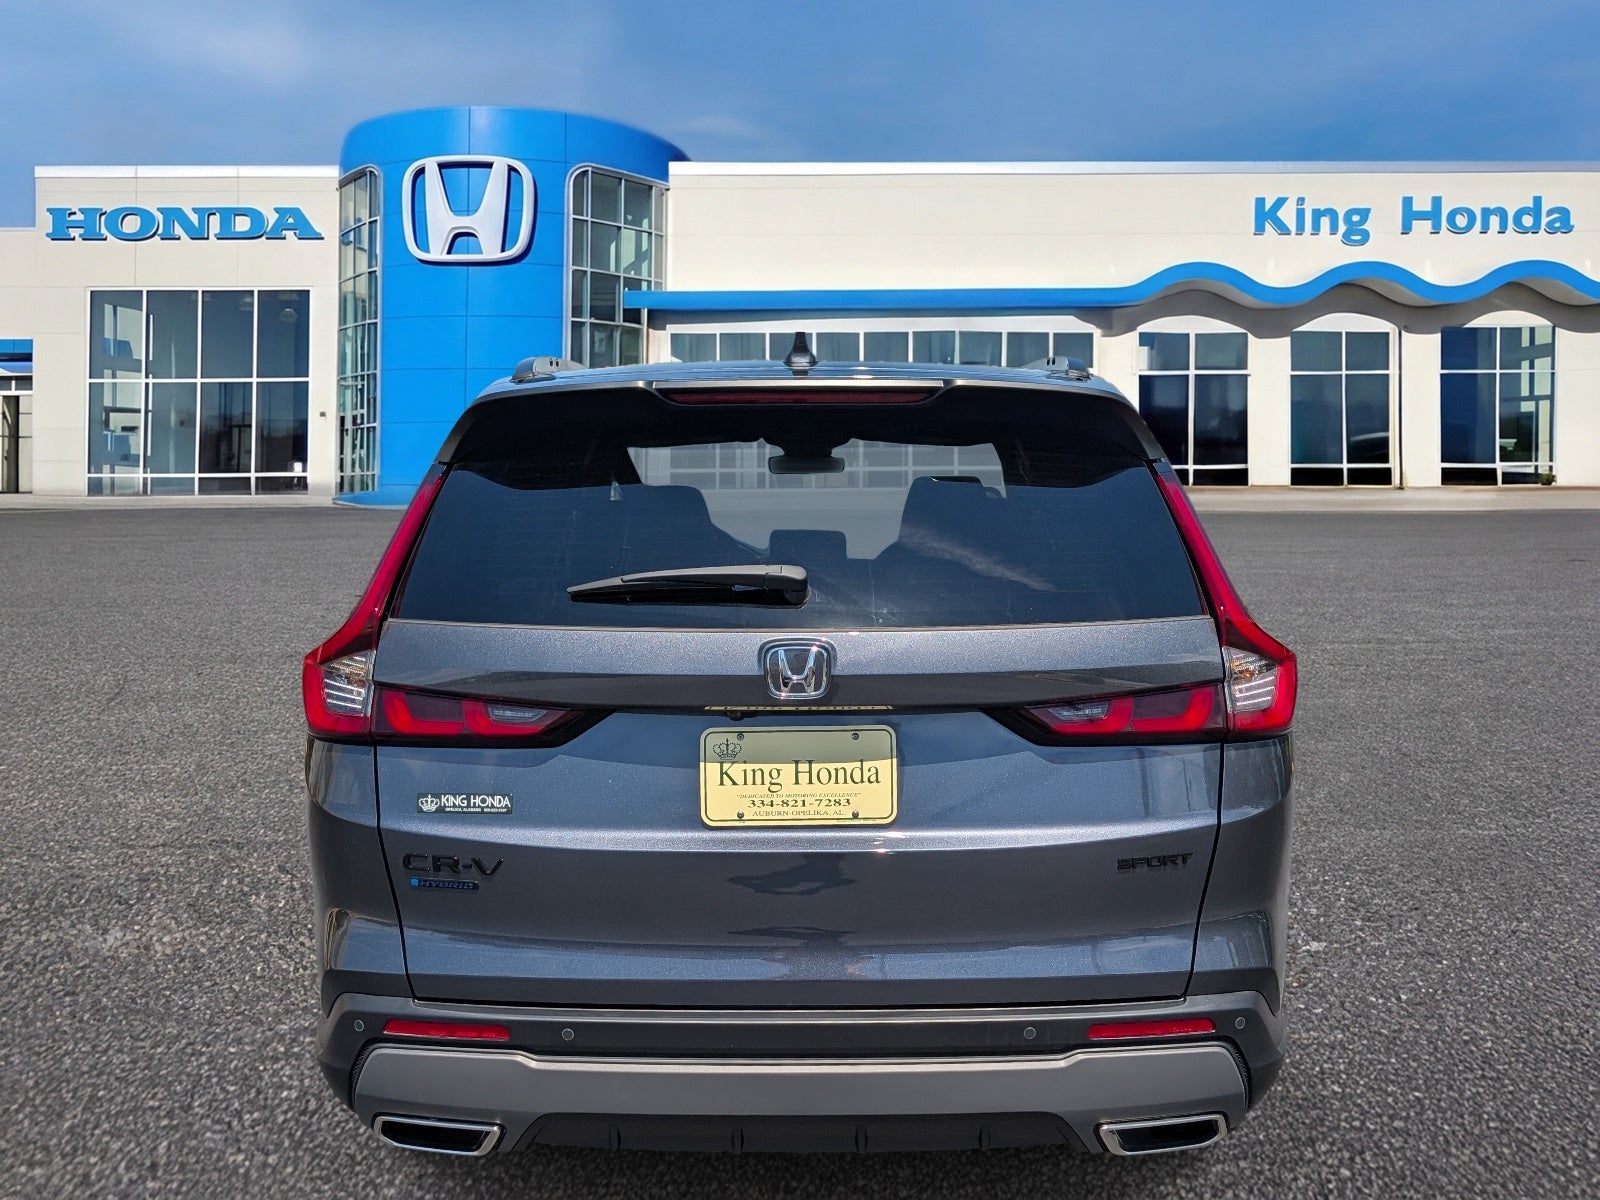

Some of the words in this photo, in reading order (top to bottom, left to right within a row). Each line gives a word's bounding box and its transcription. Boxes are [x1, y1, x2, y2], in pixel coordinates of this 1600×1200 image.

[46, 206, 324, 241] HONDA
[1253, 196, 1372, 246] King
[1400, 195, 1575, 235] Honda
[717, 759, 783, 793] King
[792, 758, 881, 786] Honda
[441, 794, 467, 807] KING
[470, 795, 512, 808] HONDA
[747, 798, 851, 808] 334-821-7283
[402, 853, 505, 876] CR-V
[1117, 852, 1194, 871] SPORT
[420, 880, 474, 889] HYBRID
